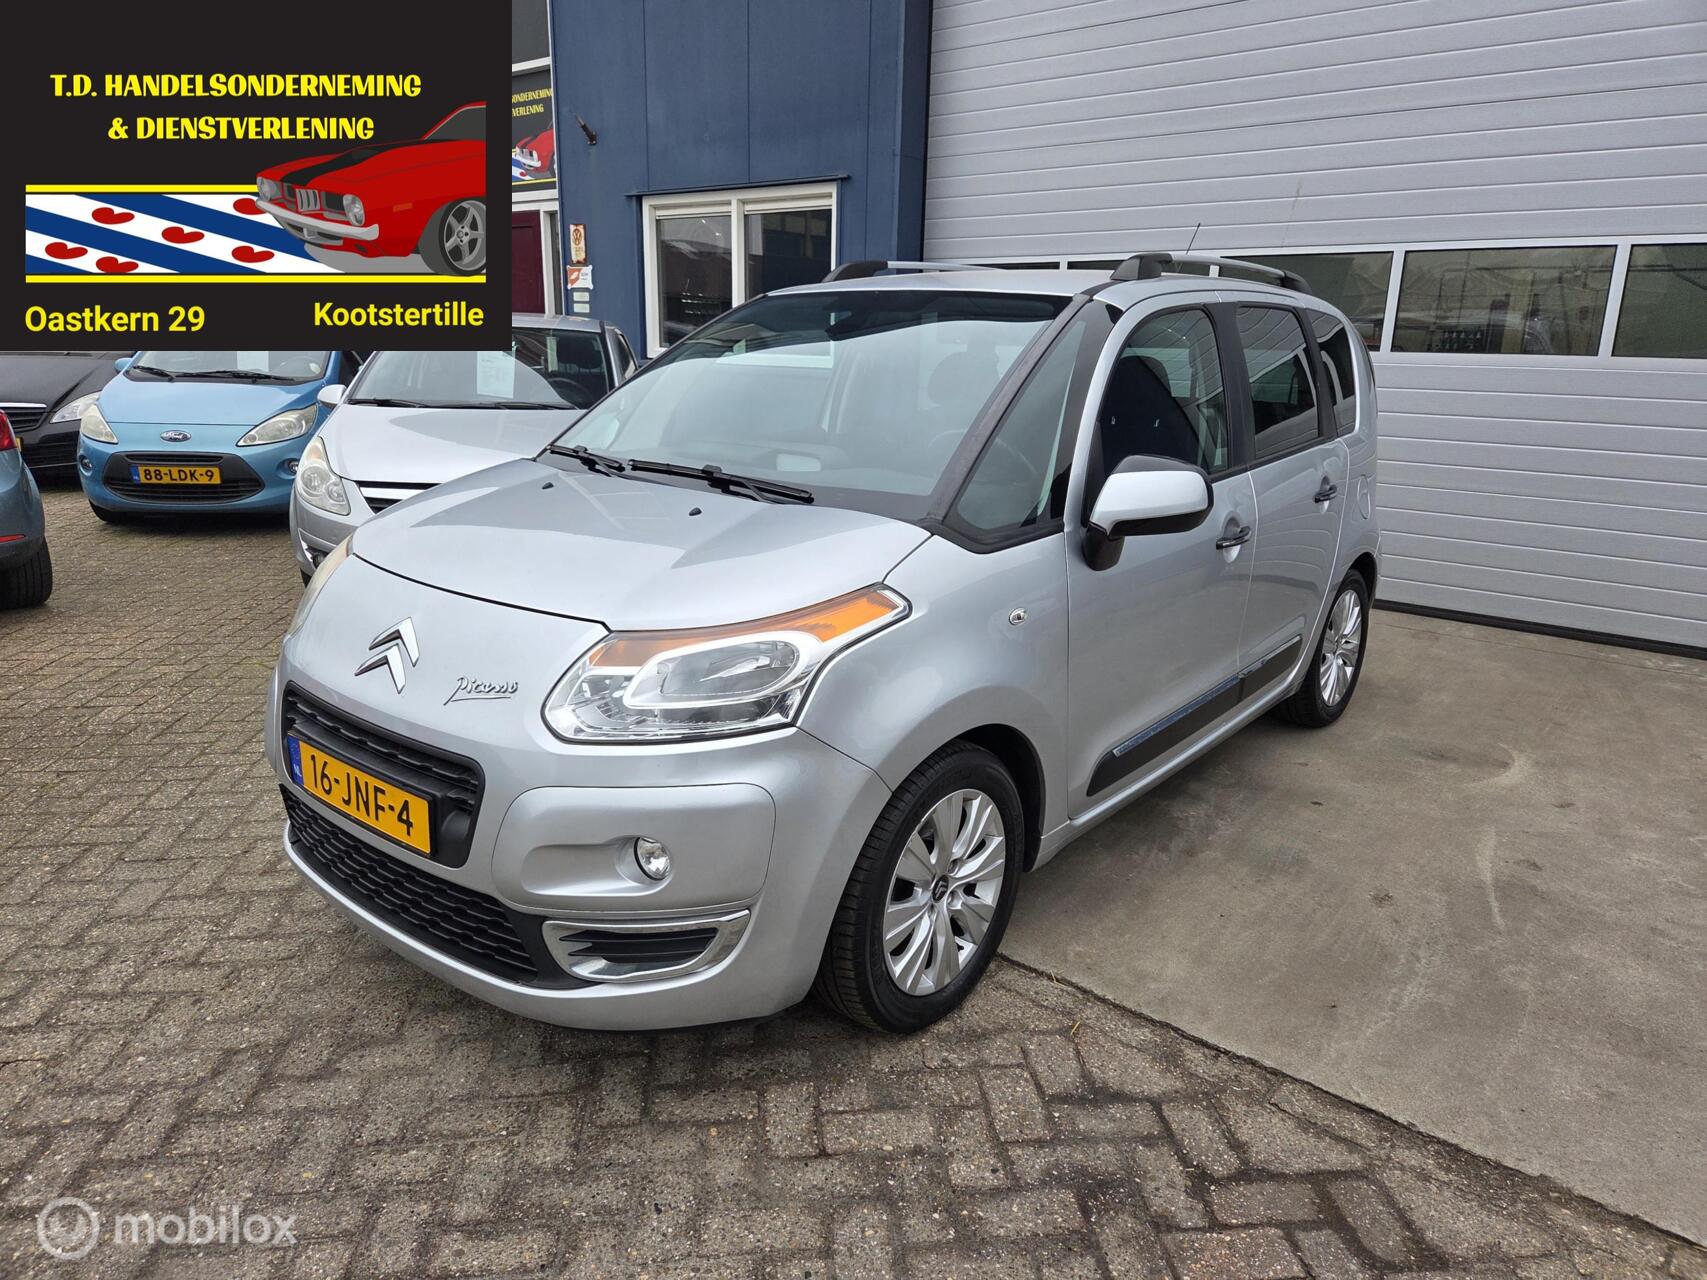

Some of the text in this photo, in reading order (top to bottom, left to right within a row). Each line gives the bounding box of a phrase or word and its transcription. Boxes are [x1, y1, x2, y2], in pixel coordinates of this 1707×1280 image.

[143, 468, 214, 482] 88-LDK-9
[293, 763, 302, 778] NL
[309, 753, 414, 837] 16-JNF-4
